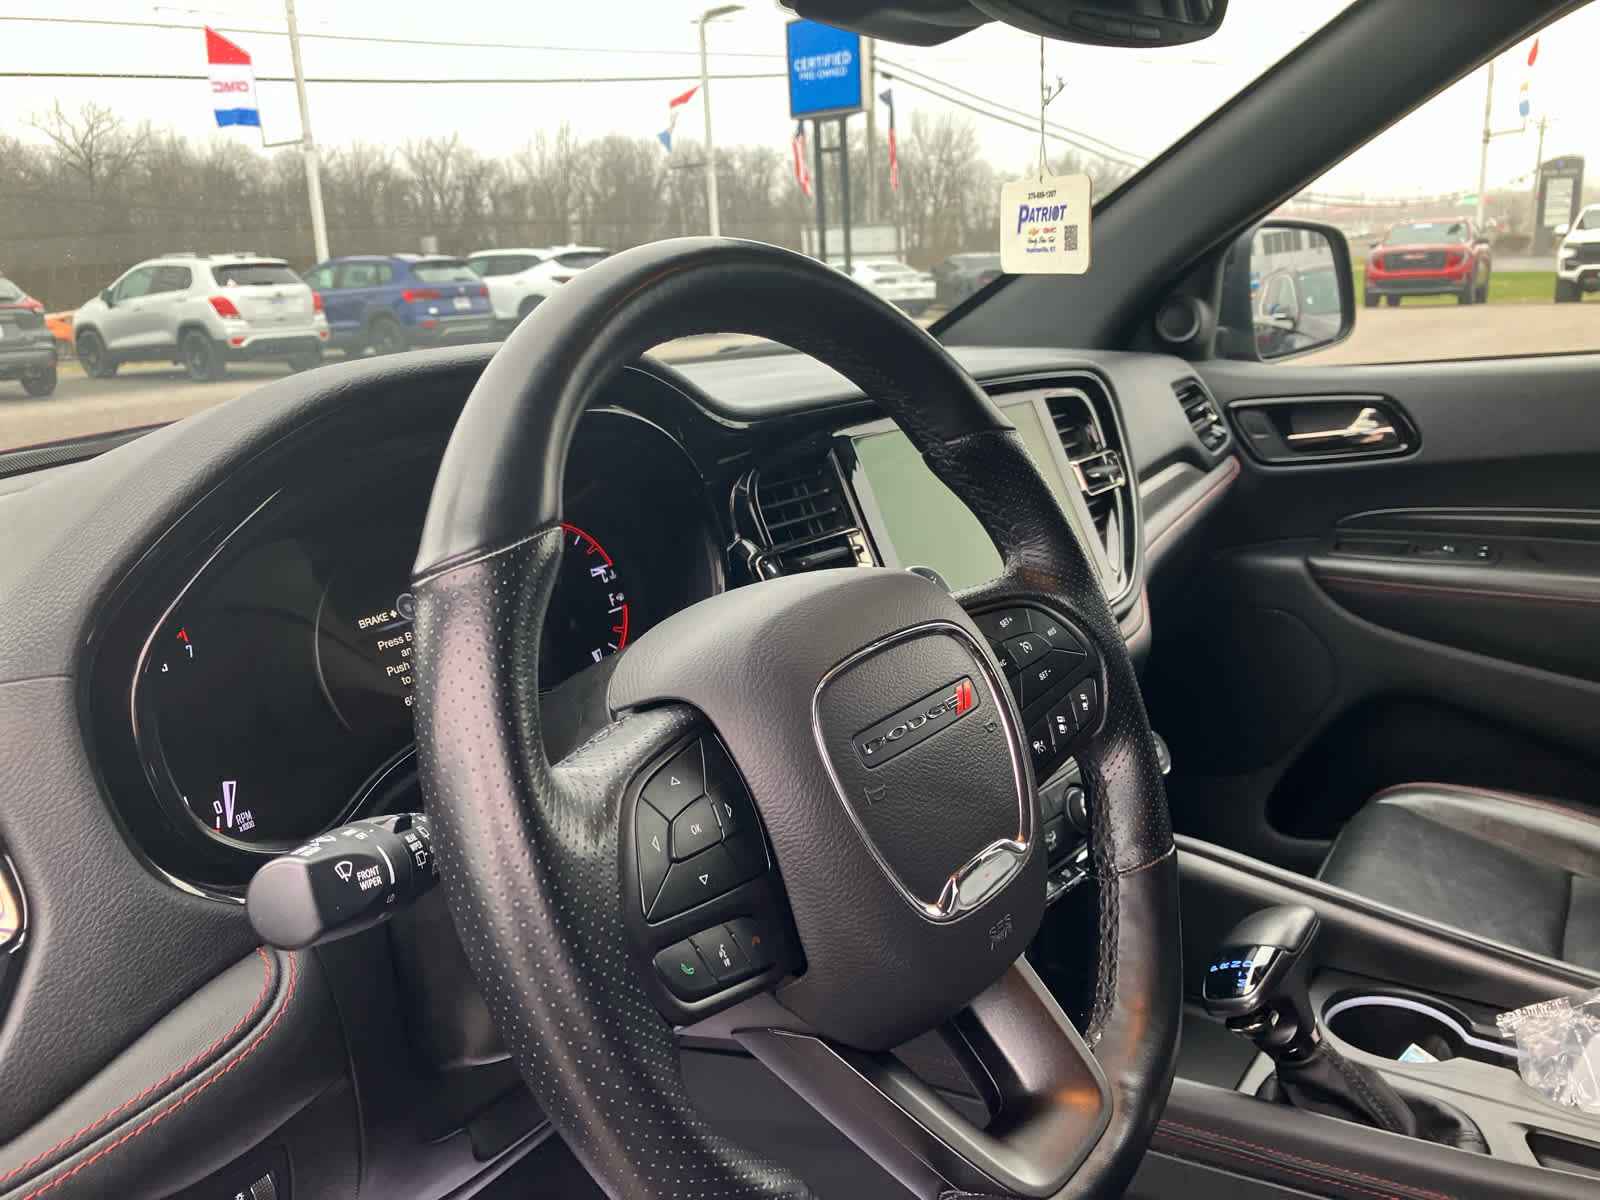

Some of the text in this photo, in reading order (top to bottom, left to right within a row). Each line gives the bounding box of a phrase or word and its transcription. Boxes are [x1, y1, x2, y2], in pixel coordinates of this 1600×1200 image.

[1017, 204, 1067, 235] PATRIOT
[358, 612, 390, 629] BRAKE
[377, 636, 404, 651] Press
[386, 661, 411, 677] Push
[401, 676, 412, 685] to
[862, 693, 961, 754] DODGE
[235, 810, 253, 826] RPM
[690, 822, 702, 835] OK
[357, 865, 380, 882] FRONT
[359, 876, 383, 892] WIPER
